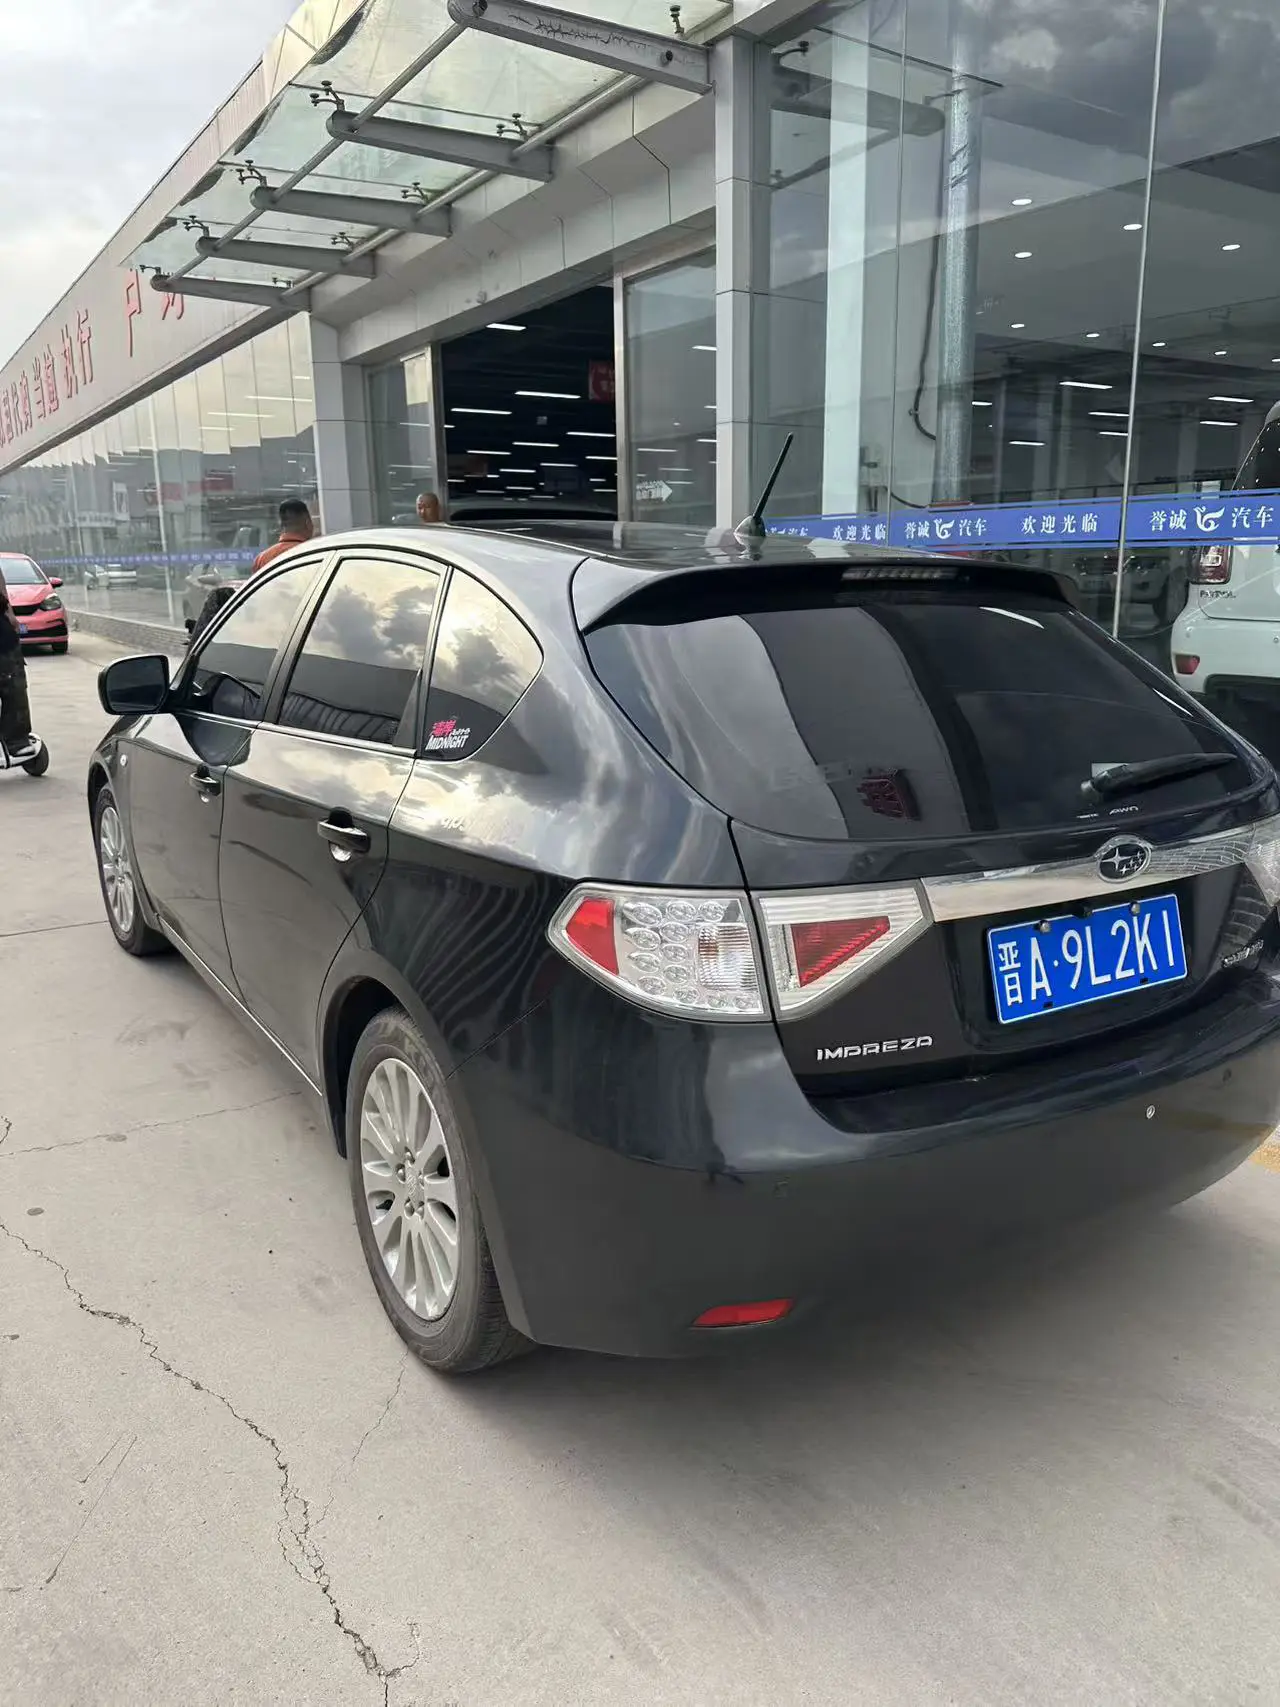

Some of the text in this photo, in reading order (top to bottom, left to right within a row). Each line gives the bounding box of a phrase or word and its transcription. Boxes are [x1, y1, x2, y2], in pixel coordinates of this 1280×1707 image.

[832, 523, 887, 542] 欢迎光临
[904, 520, 930, 541] 誉诚
[958, 517, 988, 538] 汽车
[1020, 513, 1101, 535] 欢迎光临
[1149, 508, 1188, 533] 誉诚
[1231, 504, 1275, 530] 汽车
[425, 733, 469, 752] MIDNIGHT
[815, 1034, 934, 1062] IMPREZA
